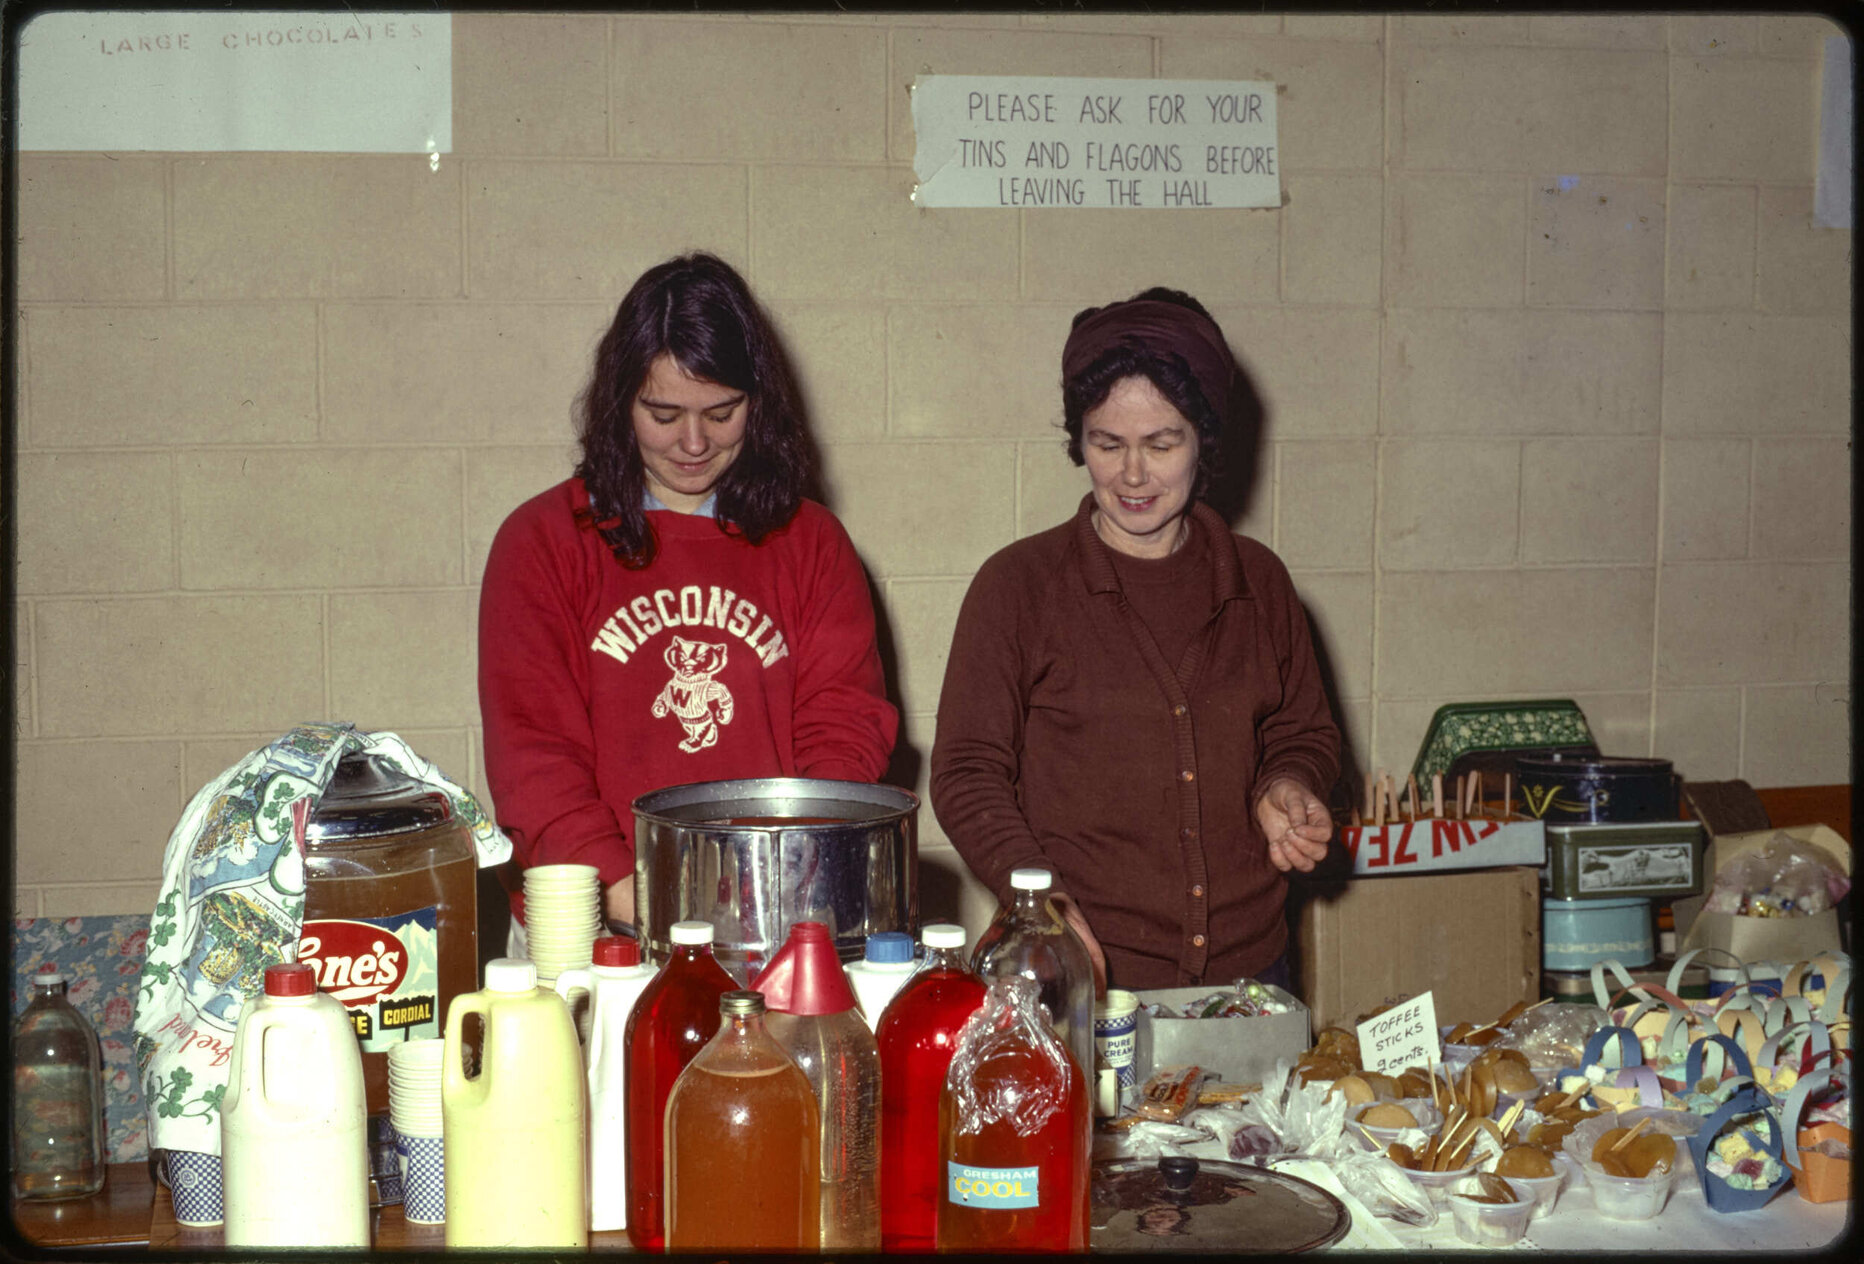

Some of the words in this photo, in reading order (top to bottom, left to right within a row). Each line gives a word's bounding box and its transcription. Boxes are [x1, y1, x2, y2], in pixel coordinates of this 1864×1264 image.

[101, 34, 190, 55] LARGE
[223, 23, 422, 49] CHOCOLATES
[968, 91, 1056, 122] PLEASE
[1080, 94, 1122, 124] ASK
[1149, 94, 1186, 125] FOR
[1206, 94, 1263, 123] YOUR
[959, 138, 1006, 168] TINS
[1025, 141, 1069, 170] AND
[1086, 142, 1182, 172] FLAGONS
[1206, 145, 1275, 175] BEFORE
[1000, 177, 1085, 206] LEAVING
[1106, 179, 1143, 206] THE
[1164, 180, 1213, 206] HALL
[591, 585, 789, 669] WISCONSIN
[669, 685, 693, 709] W
[383, 1003, 431, 1026] CORDIAL
[1369, 1005, 1420, 1038] TOFFEE
[1107, 1038, 1130, 1048] PURE
[1376, 1022, 1423, 1051] STICKS
[1104, 1046, 1133, 1057] CREAM
[955, 1177, 1031, 1198] COOL
[963, 1169, 1036, 1180] GRESHAM
